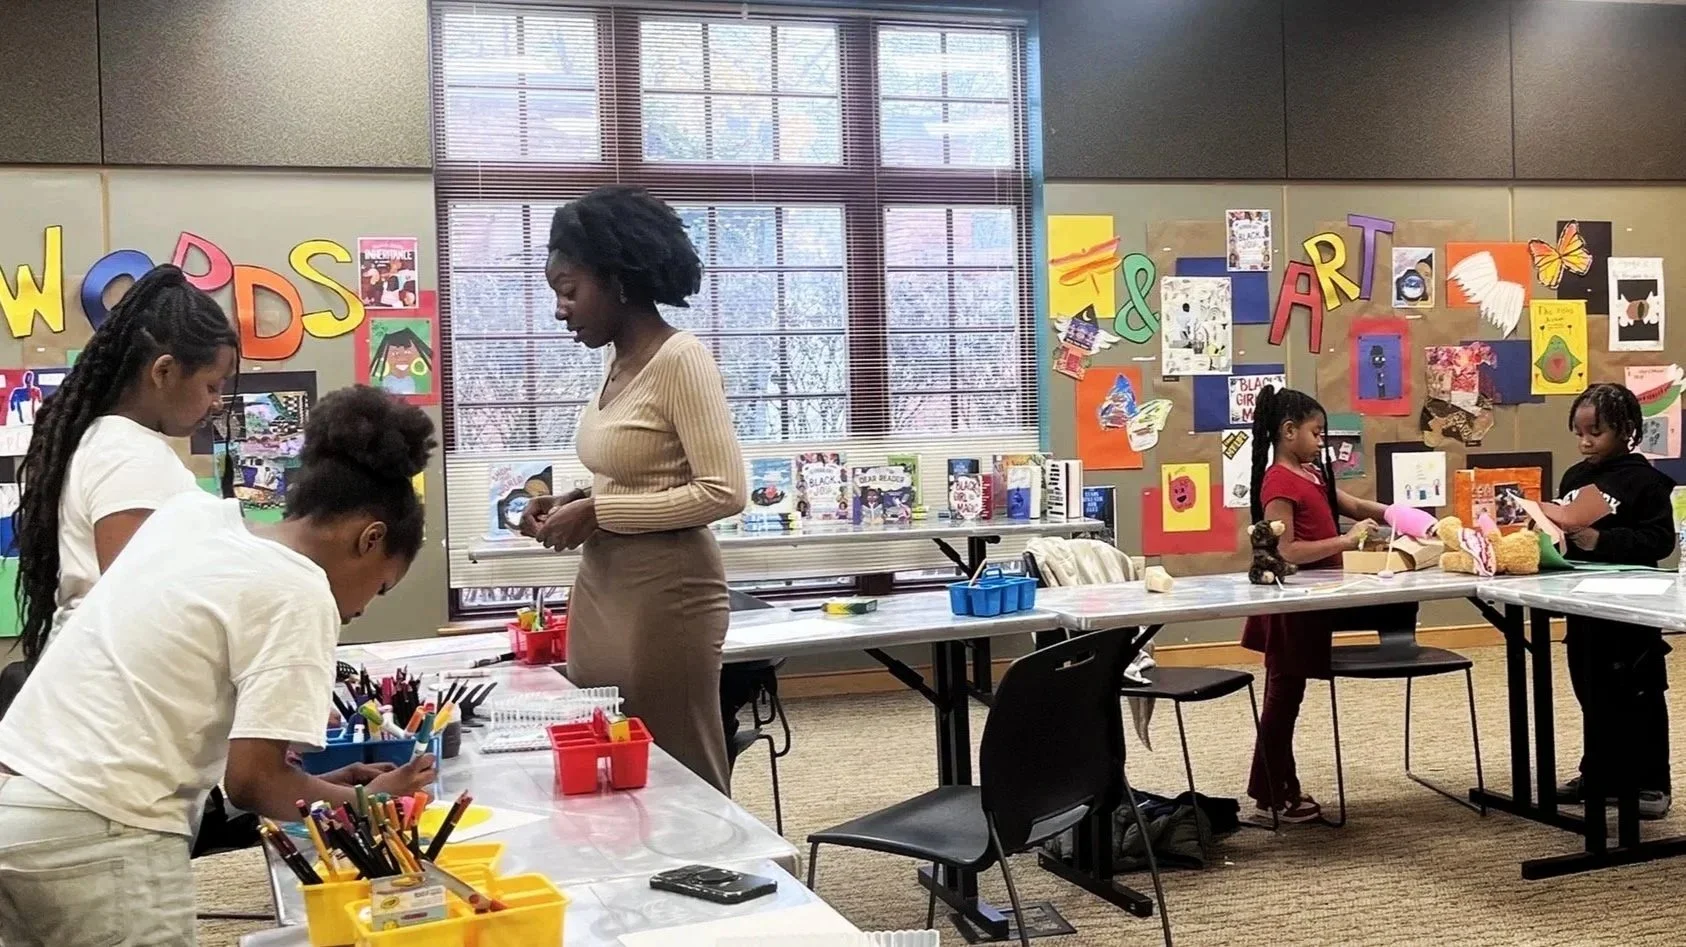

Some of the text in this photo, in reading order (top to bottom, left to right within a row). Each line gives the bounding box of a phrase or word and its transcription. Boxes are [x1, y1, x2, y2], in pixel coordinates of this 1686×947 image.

[1113, 214, 1394, 354] & ART
[809, 476, 836, 488] BLACK
[859, 475, 904, 484] DEAR READER
